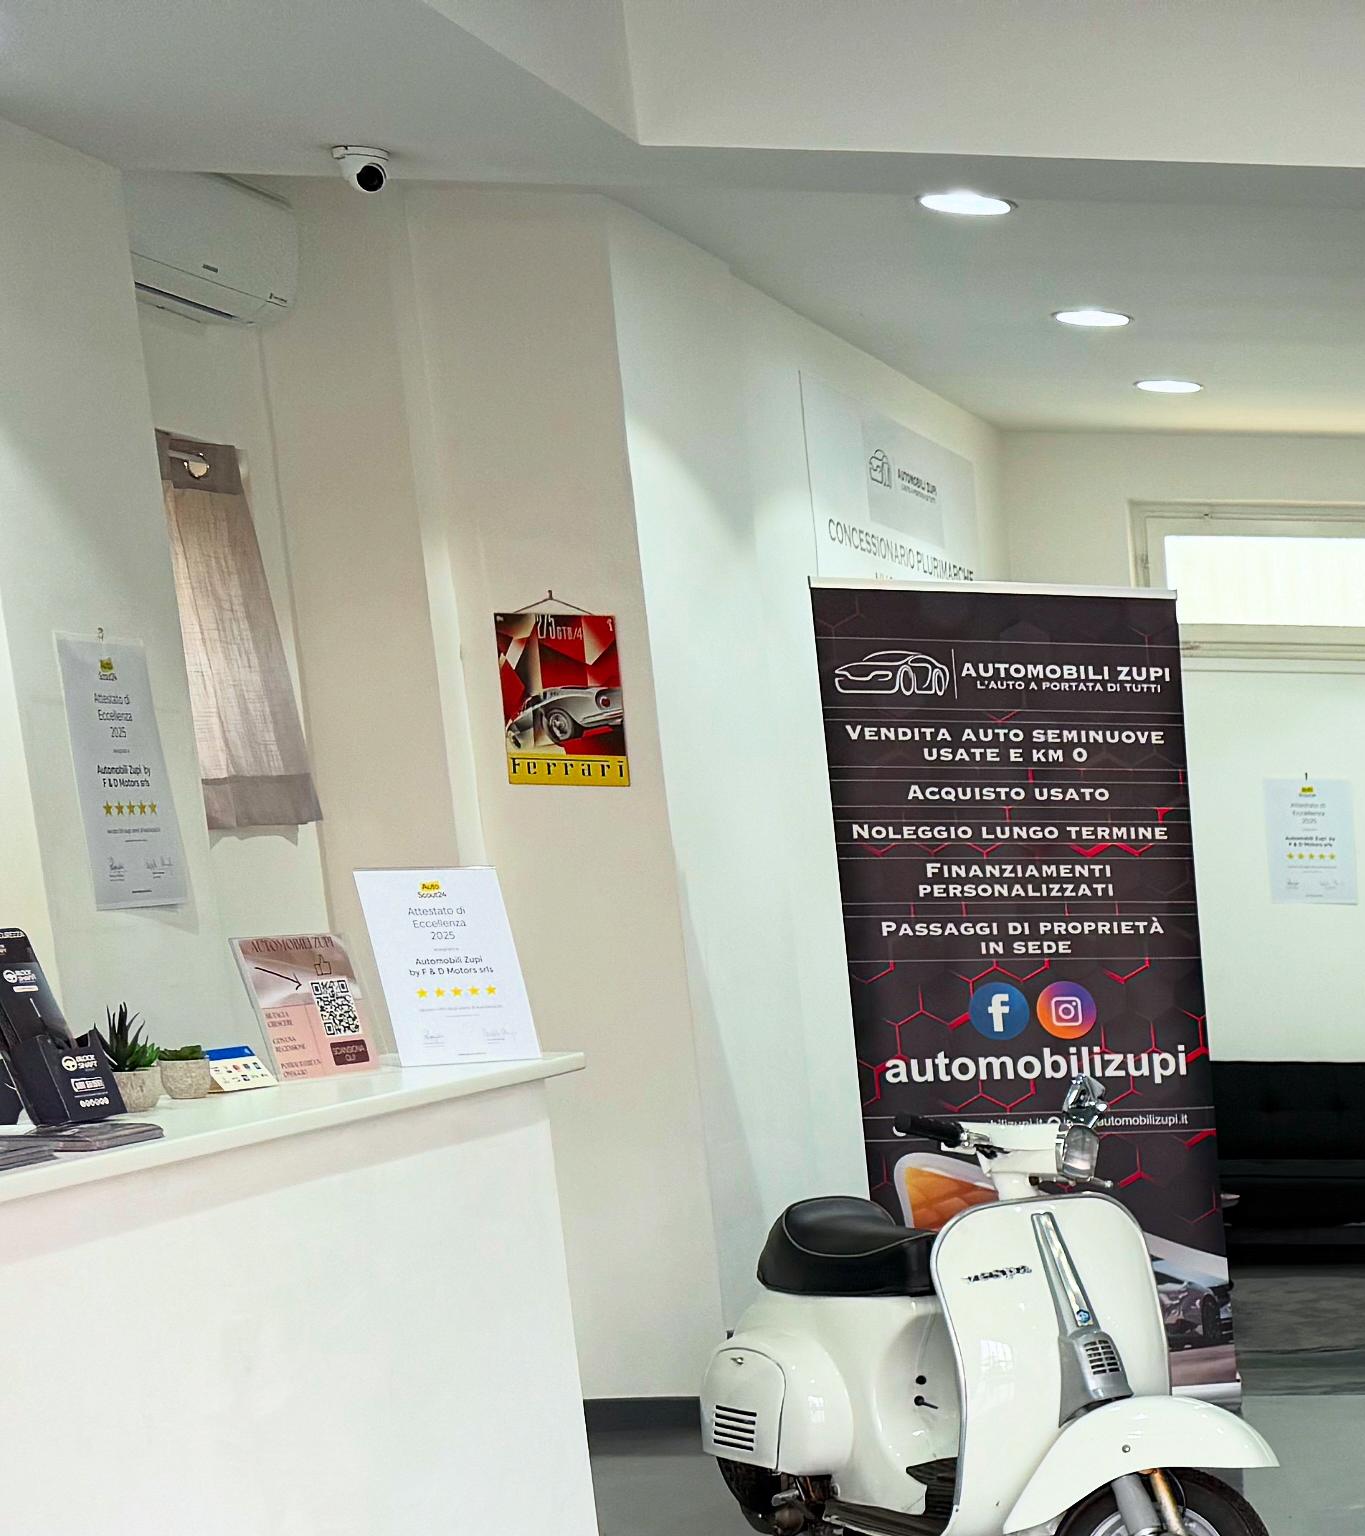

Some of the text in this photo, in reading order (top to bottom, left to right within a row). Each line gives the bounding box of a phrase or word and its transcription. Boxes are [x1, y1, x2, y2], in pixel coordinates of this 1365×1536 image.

[828, 518, 915, 569] CONCESSIONARIO
[961, 663, 1170, 682] AUTOMOBILI ZUPI
[977, 680, 1161, 693] L'AUTO A PORTATA DI TUTTI
[845, 724, 1165, 745] VENDITA AUTO SEMINUOVE
[923, 747, 1000, 762] USATE
[1009, 748, 1023, 762] E
[1032, 749, 1063, 763] KM
[510, 757, 625, 778] Ferrari
[907, 785, 1110, 802] ACQUISTO USATO
[852, 824, 1168, 840] NOLEGGIO LUNGO TERMINE
[926, 863, 1112, 878] FINANZIAMENTI
[417, 891, 447, 899] Scout24
[918, 884, 1114, 898] PERSONALIZZATI
[408, 906, 466, 916] Attestato di
[413, 919, 466, 929] Eccellenza
[881, 916, 1165, 937] PASSAGGI DI PROPRIETÀ
[431, 931, 456, 940] 2025
[251, 938, 311, 953] AUTOMOBILI
[981, 940, 1071, 955] IN SEDE
[415, 955, 483, 967] Automobili Zupi
[409, 967, 420, 978] by
[422, 967, 428, 976] F
[438, 967, 445, 976] D
[447, 966, 478, 975] Motors
[885, 1044, 1187, 1084] automobilizupi
